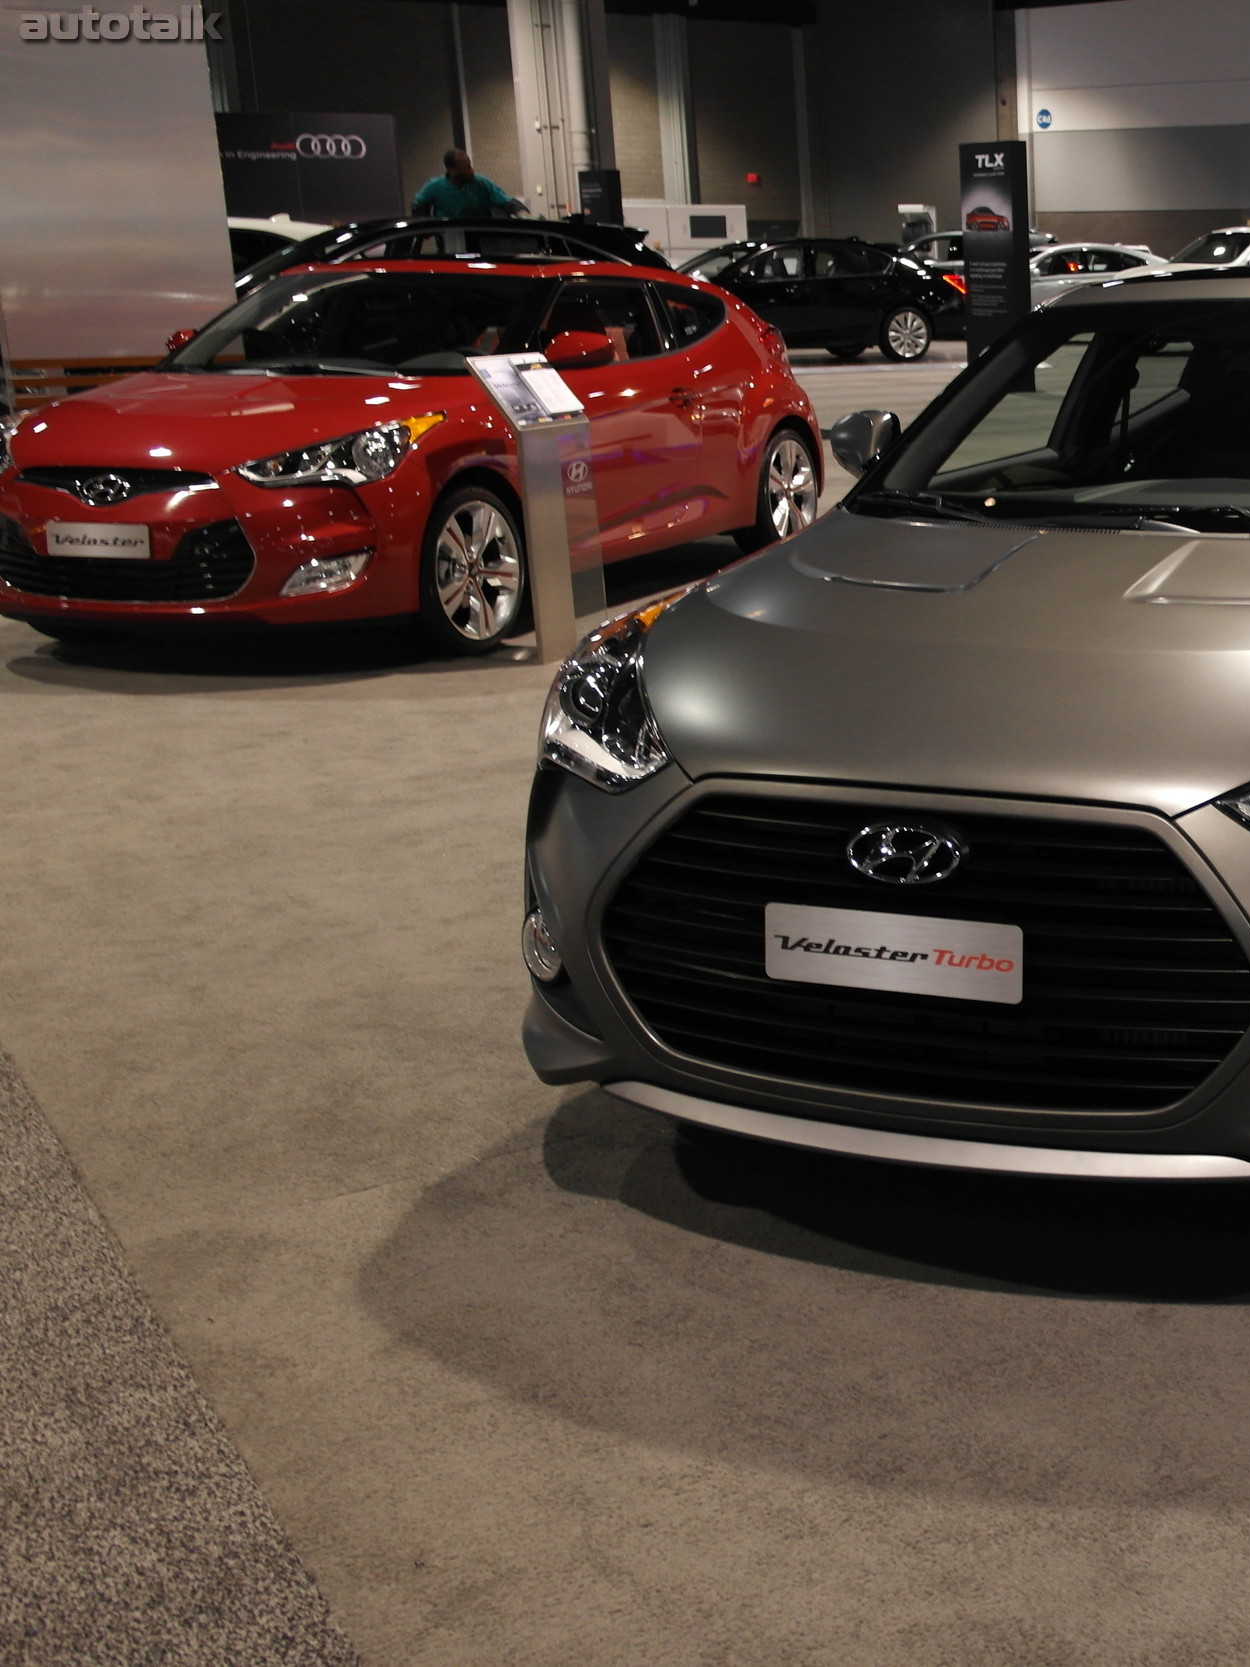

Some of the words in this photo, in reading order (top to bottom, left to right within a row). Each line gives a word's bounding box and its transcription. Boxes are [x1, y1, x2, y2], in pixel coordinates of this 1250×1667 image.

[271, 142, 296, 150] Audi
[237, 151, 297, 161] Engineering
[975, 152, 1005, 169] TLX
[49, 533, 144, 547] Veloster
[774, 934, 928, 963] Veloster
[932, 949, 1015, 973] Turbo
